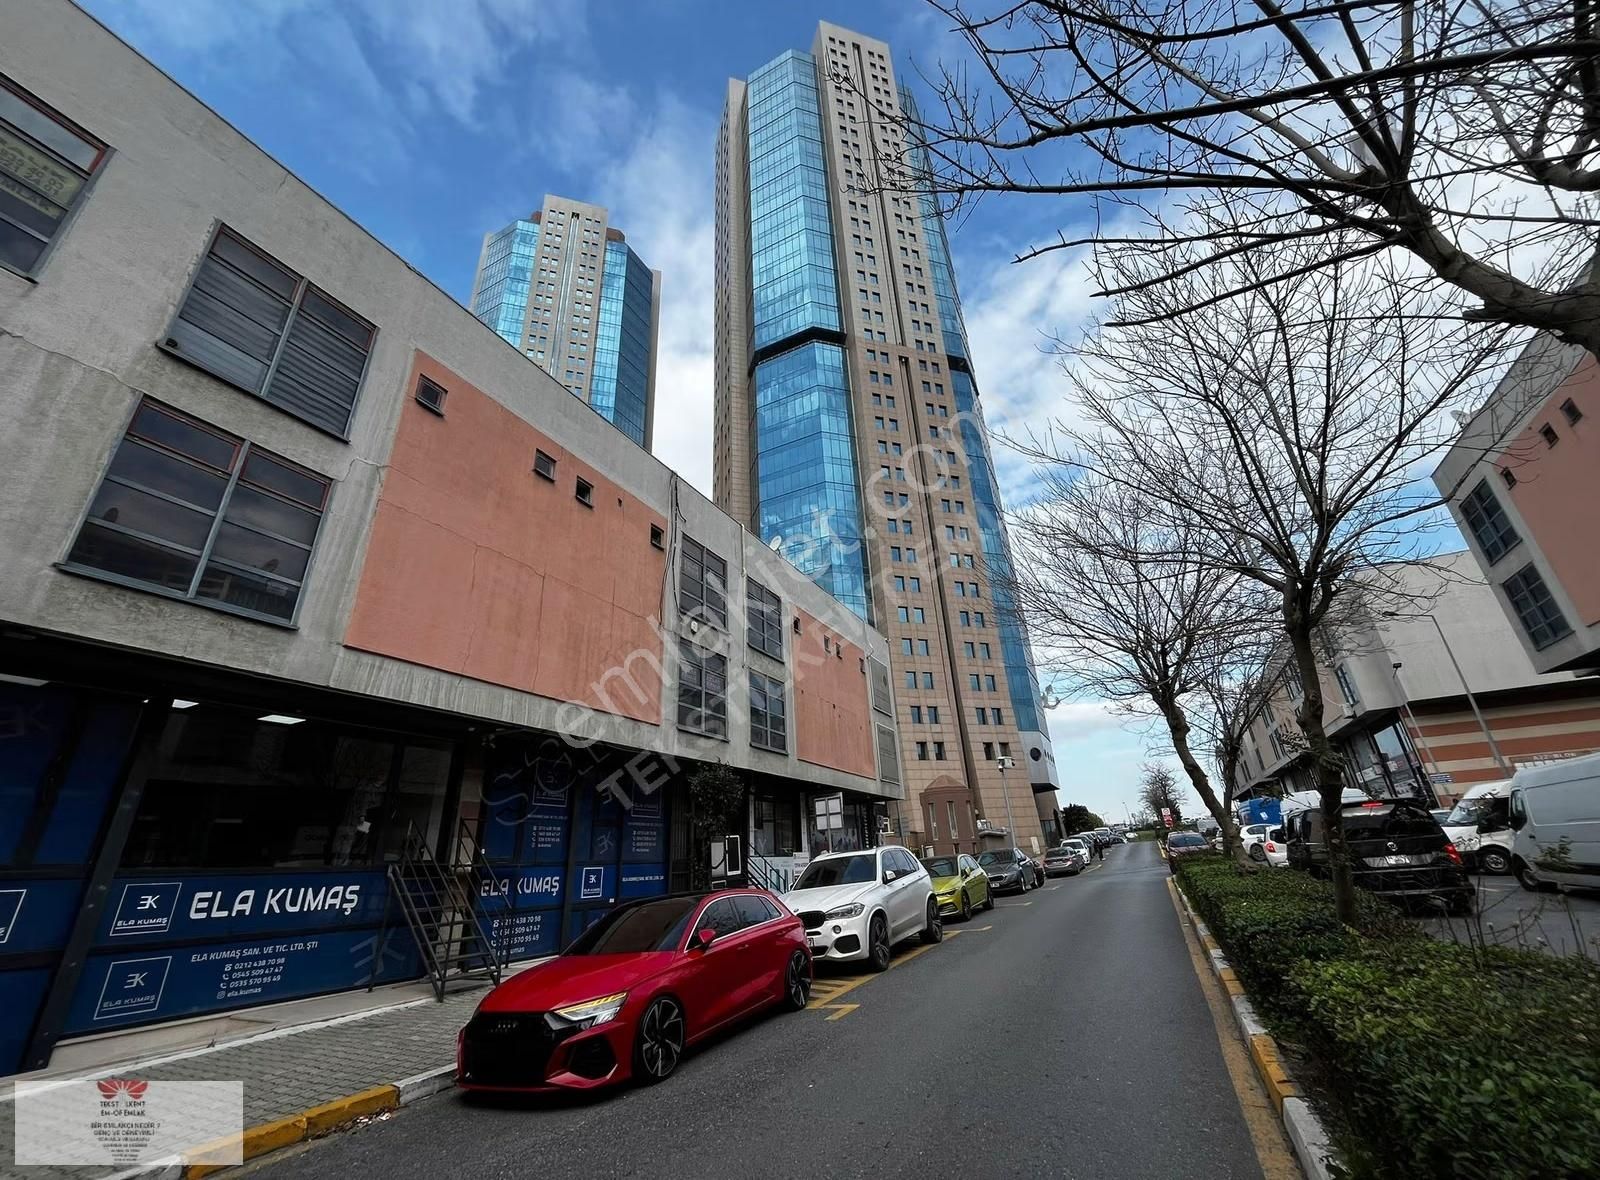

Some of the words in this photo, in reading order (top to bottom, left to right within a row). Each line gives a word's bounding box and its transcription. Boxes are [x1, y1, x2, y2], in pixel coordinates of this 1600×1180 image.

[189, 890, 256, 920] ELA
[263, 885, 361, 917] KUMAŞ
[190, 953, 208, 963] ELA
[209, 949, 241, 960] KUMAŞ
[242, 947, 261, 957] SAN.
[263, 945, 274, 954] VE
